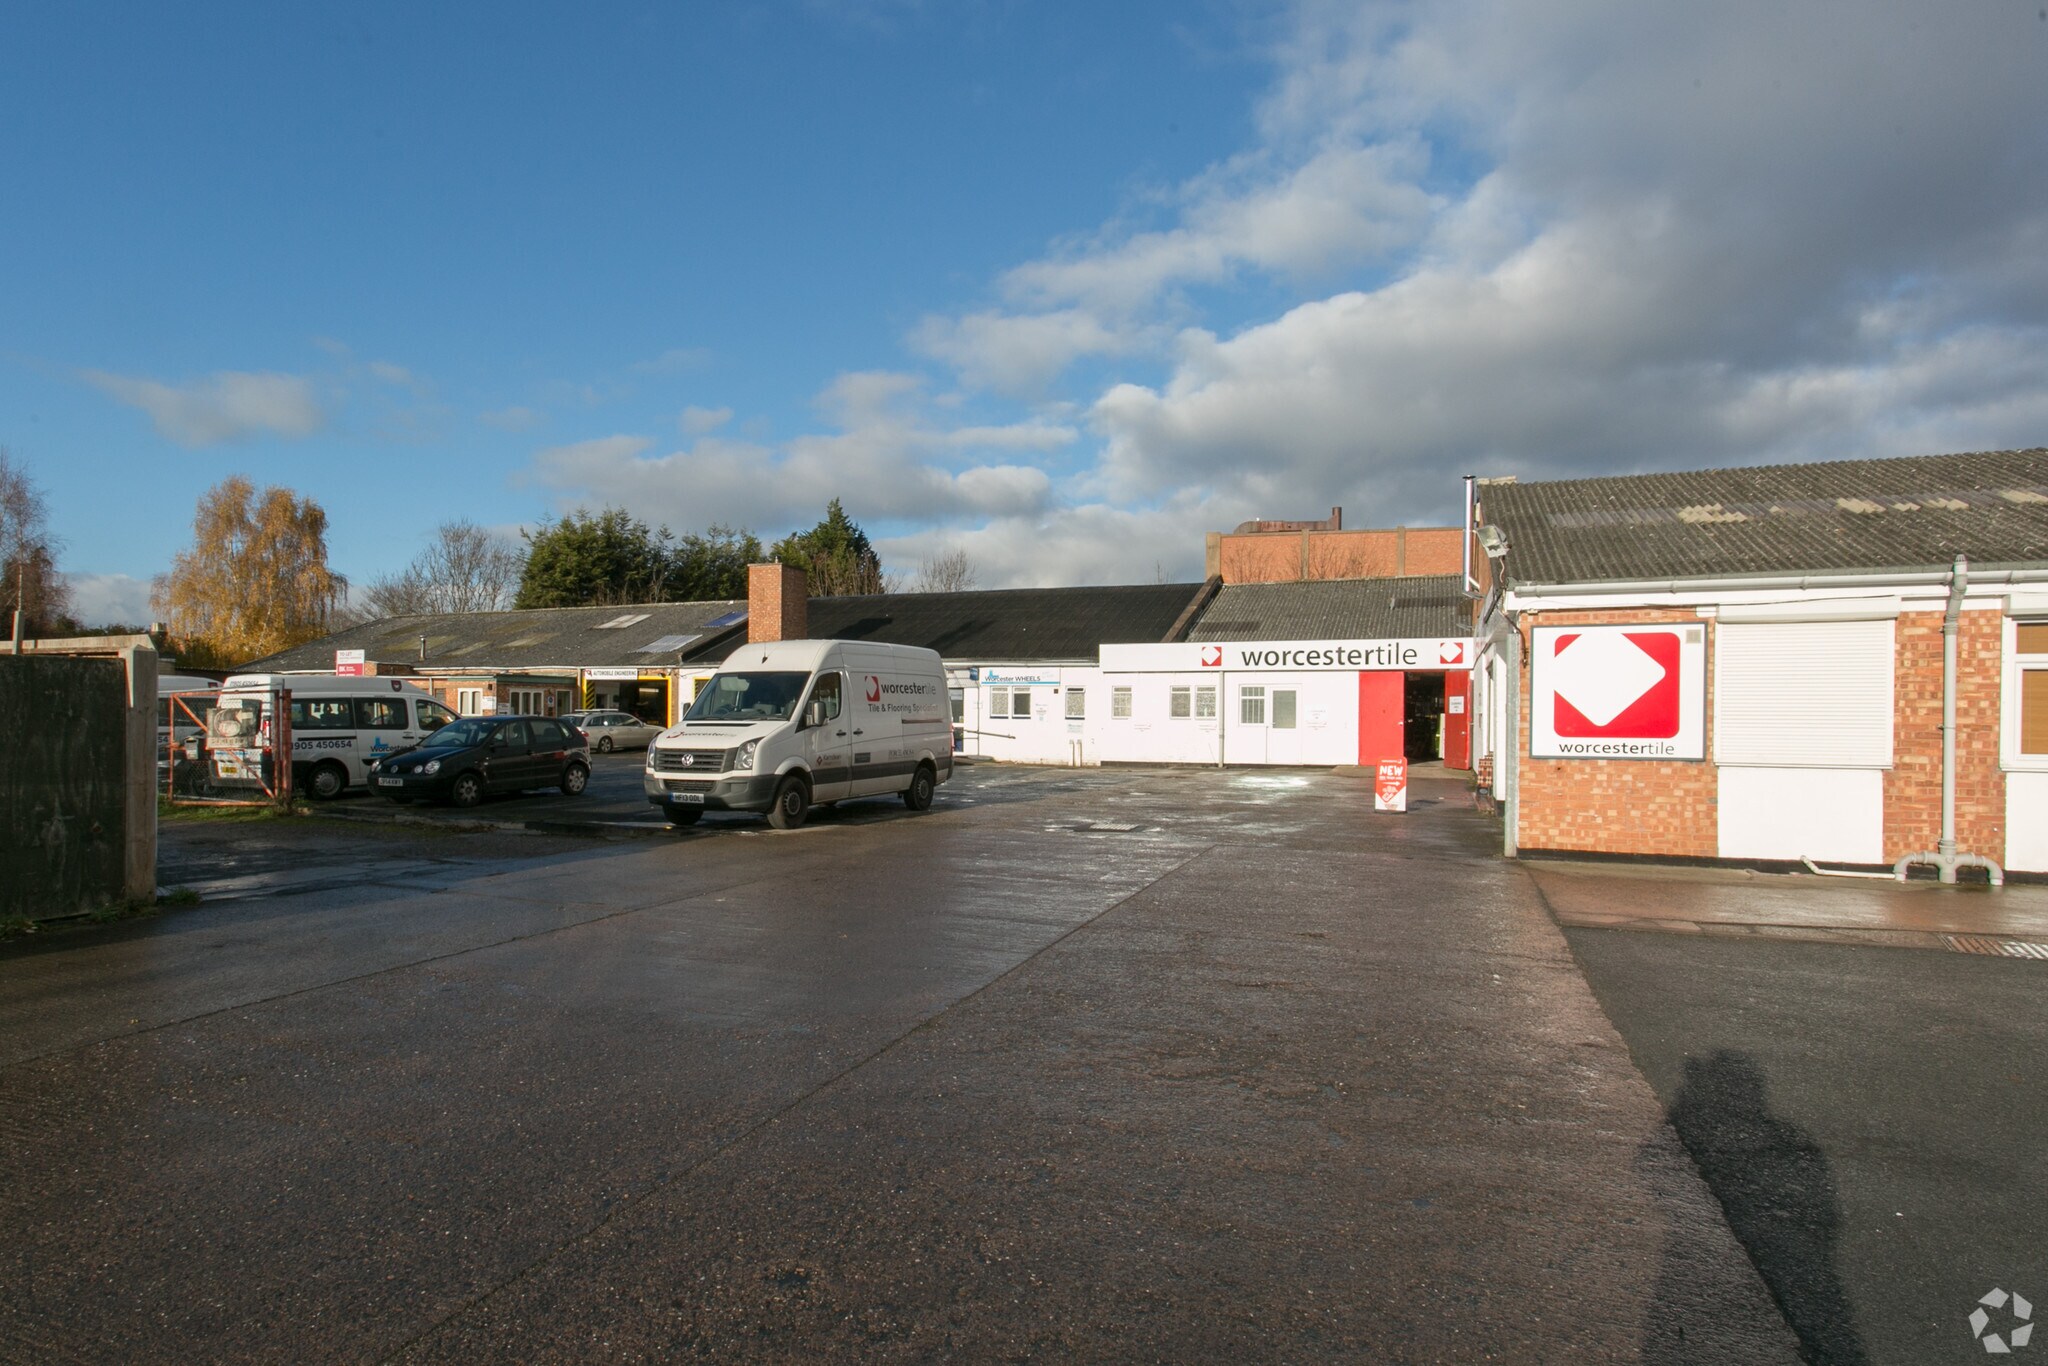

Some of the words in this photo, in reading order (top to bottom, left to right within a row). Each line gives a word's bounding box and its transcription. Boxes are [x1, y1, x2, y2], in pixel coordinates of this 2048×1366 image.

[1241, 642, 1418, 666] worcestertile
[881, 682, 937, 695] worcestertile
[868, 704, 880, 712] Tile
[881, 704, 886, 712] &
[887, 704, 912, 714] Flooring
[316, 740, 352, 749] 450654
[1559, 742, 1675, 755] worcestertile
[1379, 765, 1404, 776] NEW
